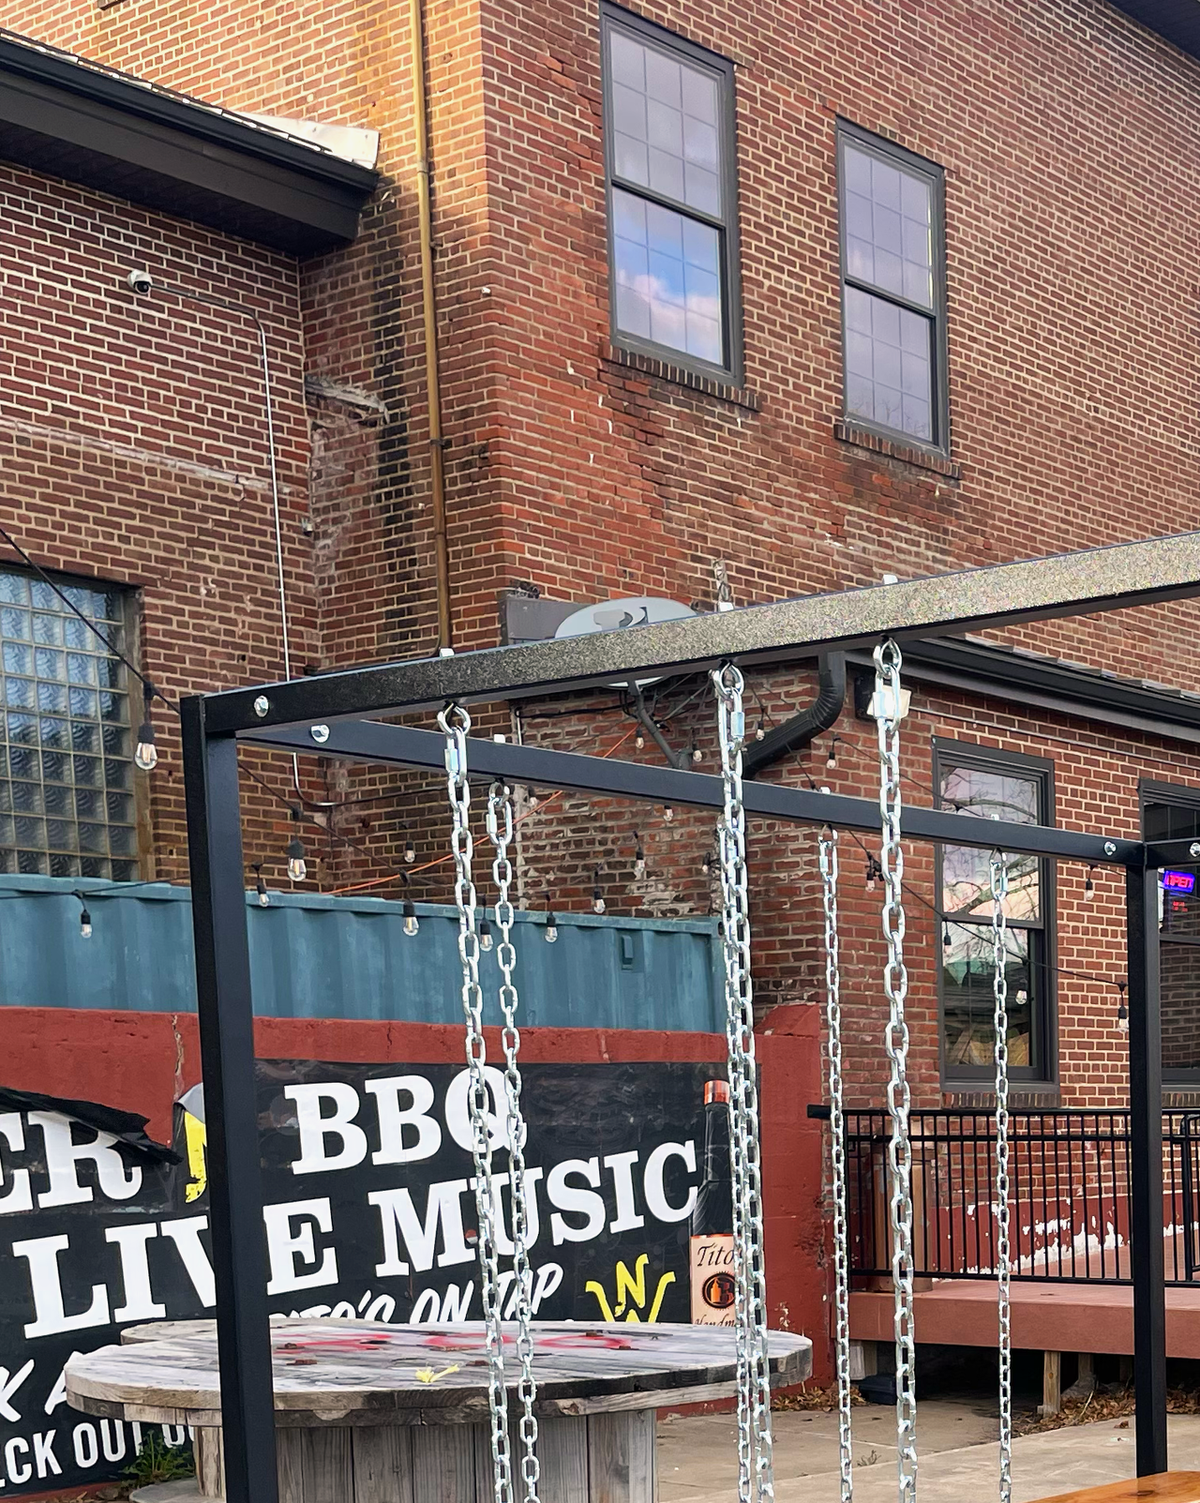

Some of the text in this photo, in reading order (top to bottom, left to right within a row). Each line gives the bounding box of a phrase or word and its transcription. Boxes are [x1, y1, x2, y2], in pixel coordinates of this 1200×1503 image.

[284, 1065, 528, 1176] BBQ
[12, 1197, 339, 1340] LIVE
[367, 1140, 698, 1278] MUSIC
